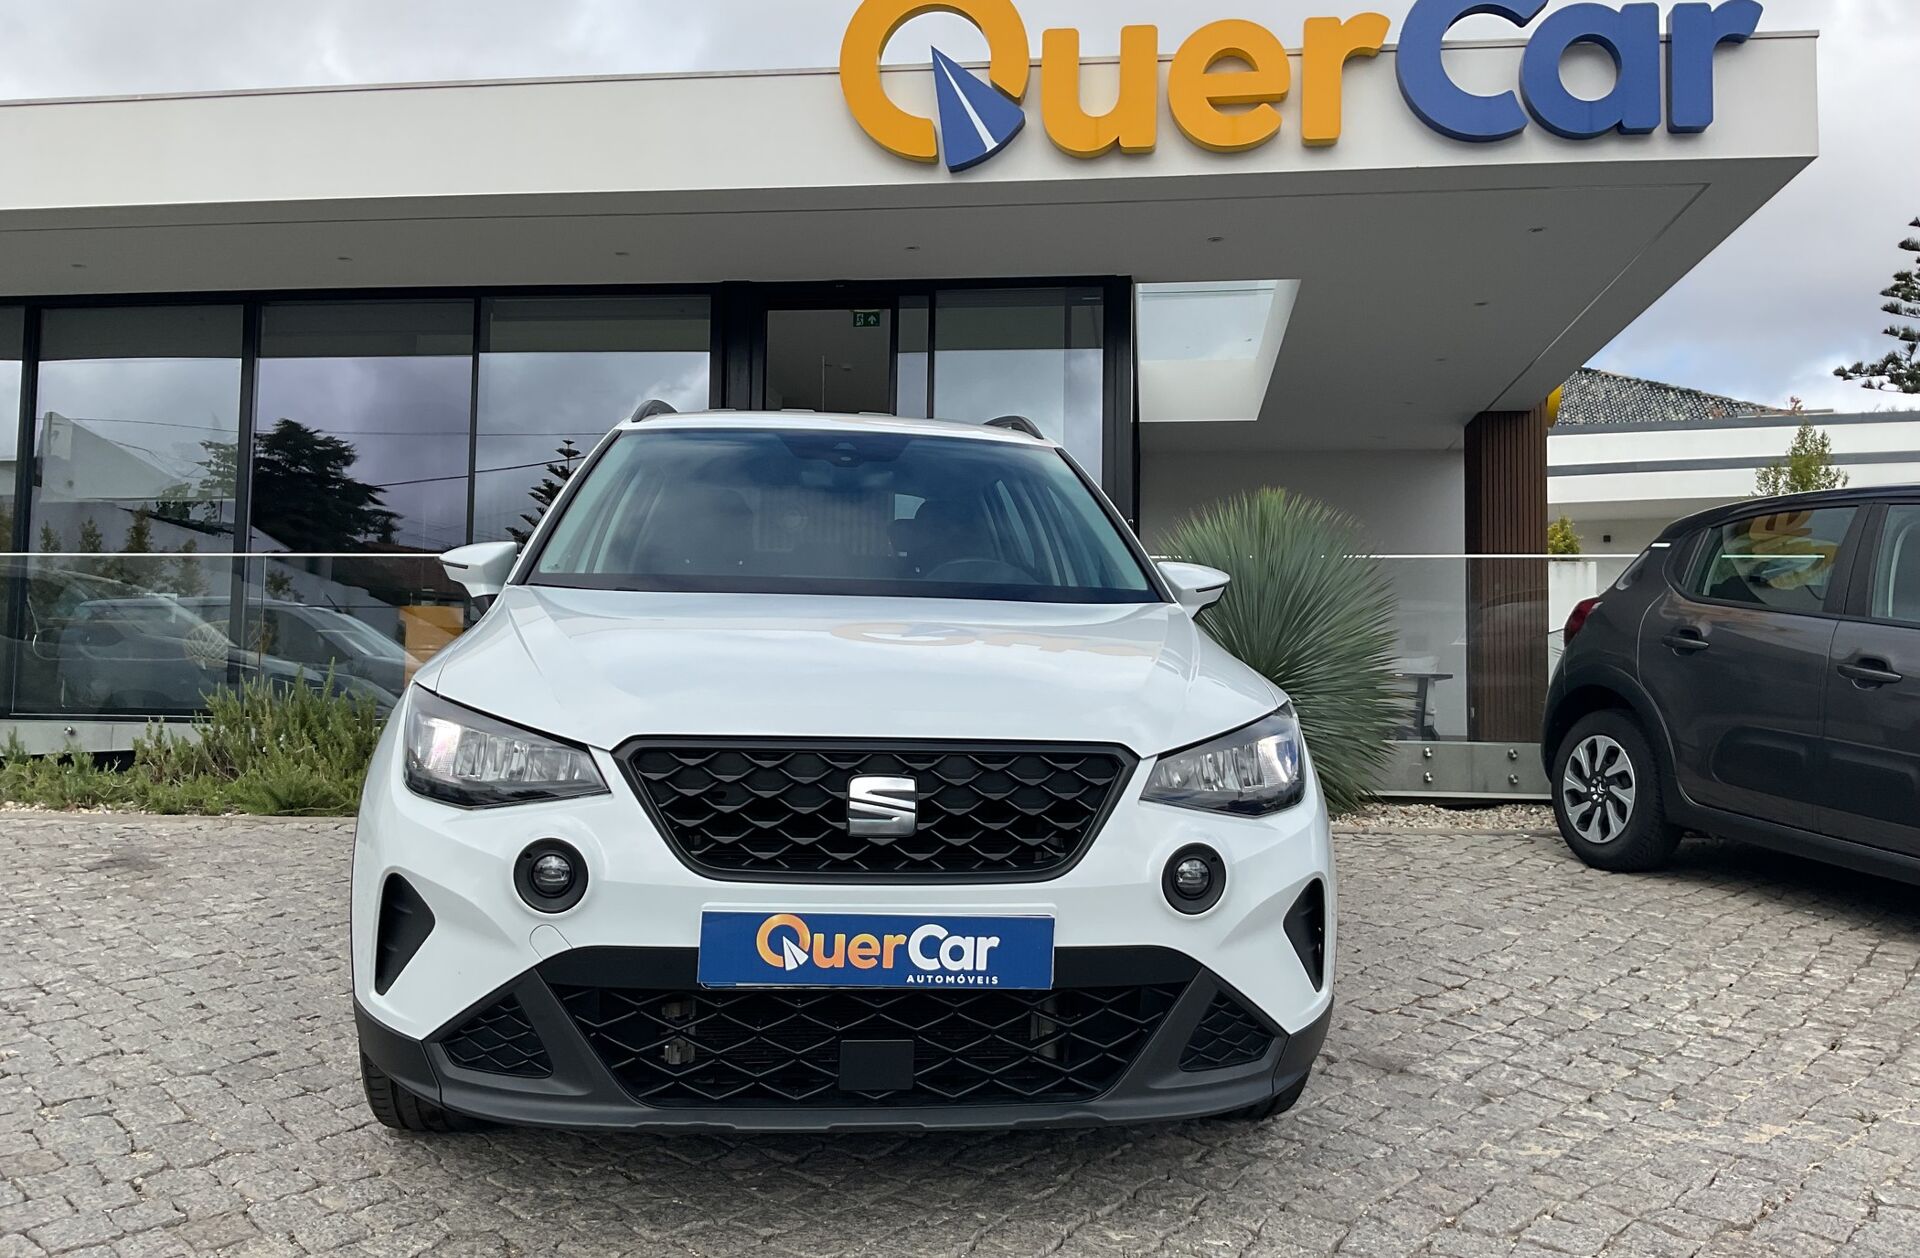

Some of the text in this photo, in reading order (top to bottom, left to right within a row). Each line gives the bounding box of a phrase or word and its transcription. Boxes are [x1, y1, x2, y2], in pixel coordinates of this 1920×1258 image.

[840, 0, 1763, 172] QuerCar
[756, 913, 1000, 971] QuerCar
[906, 972, 999, 985] AUTOMÓVEIS
